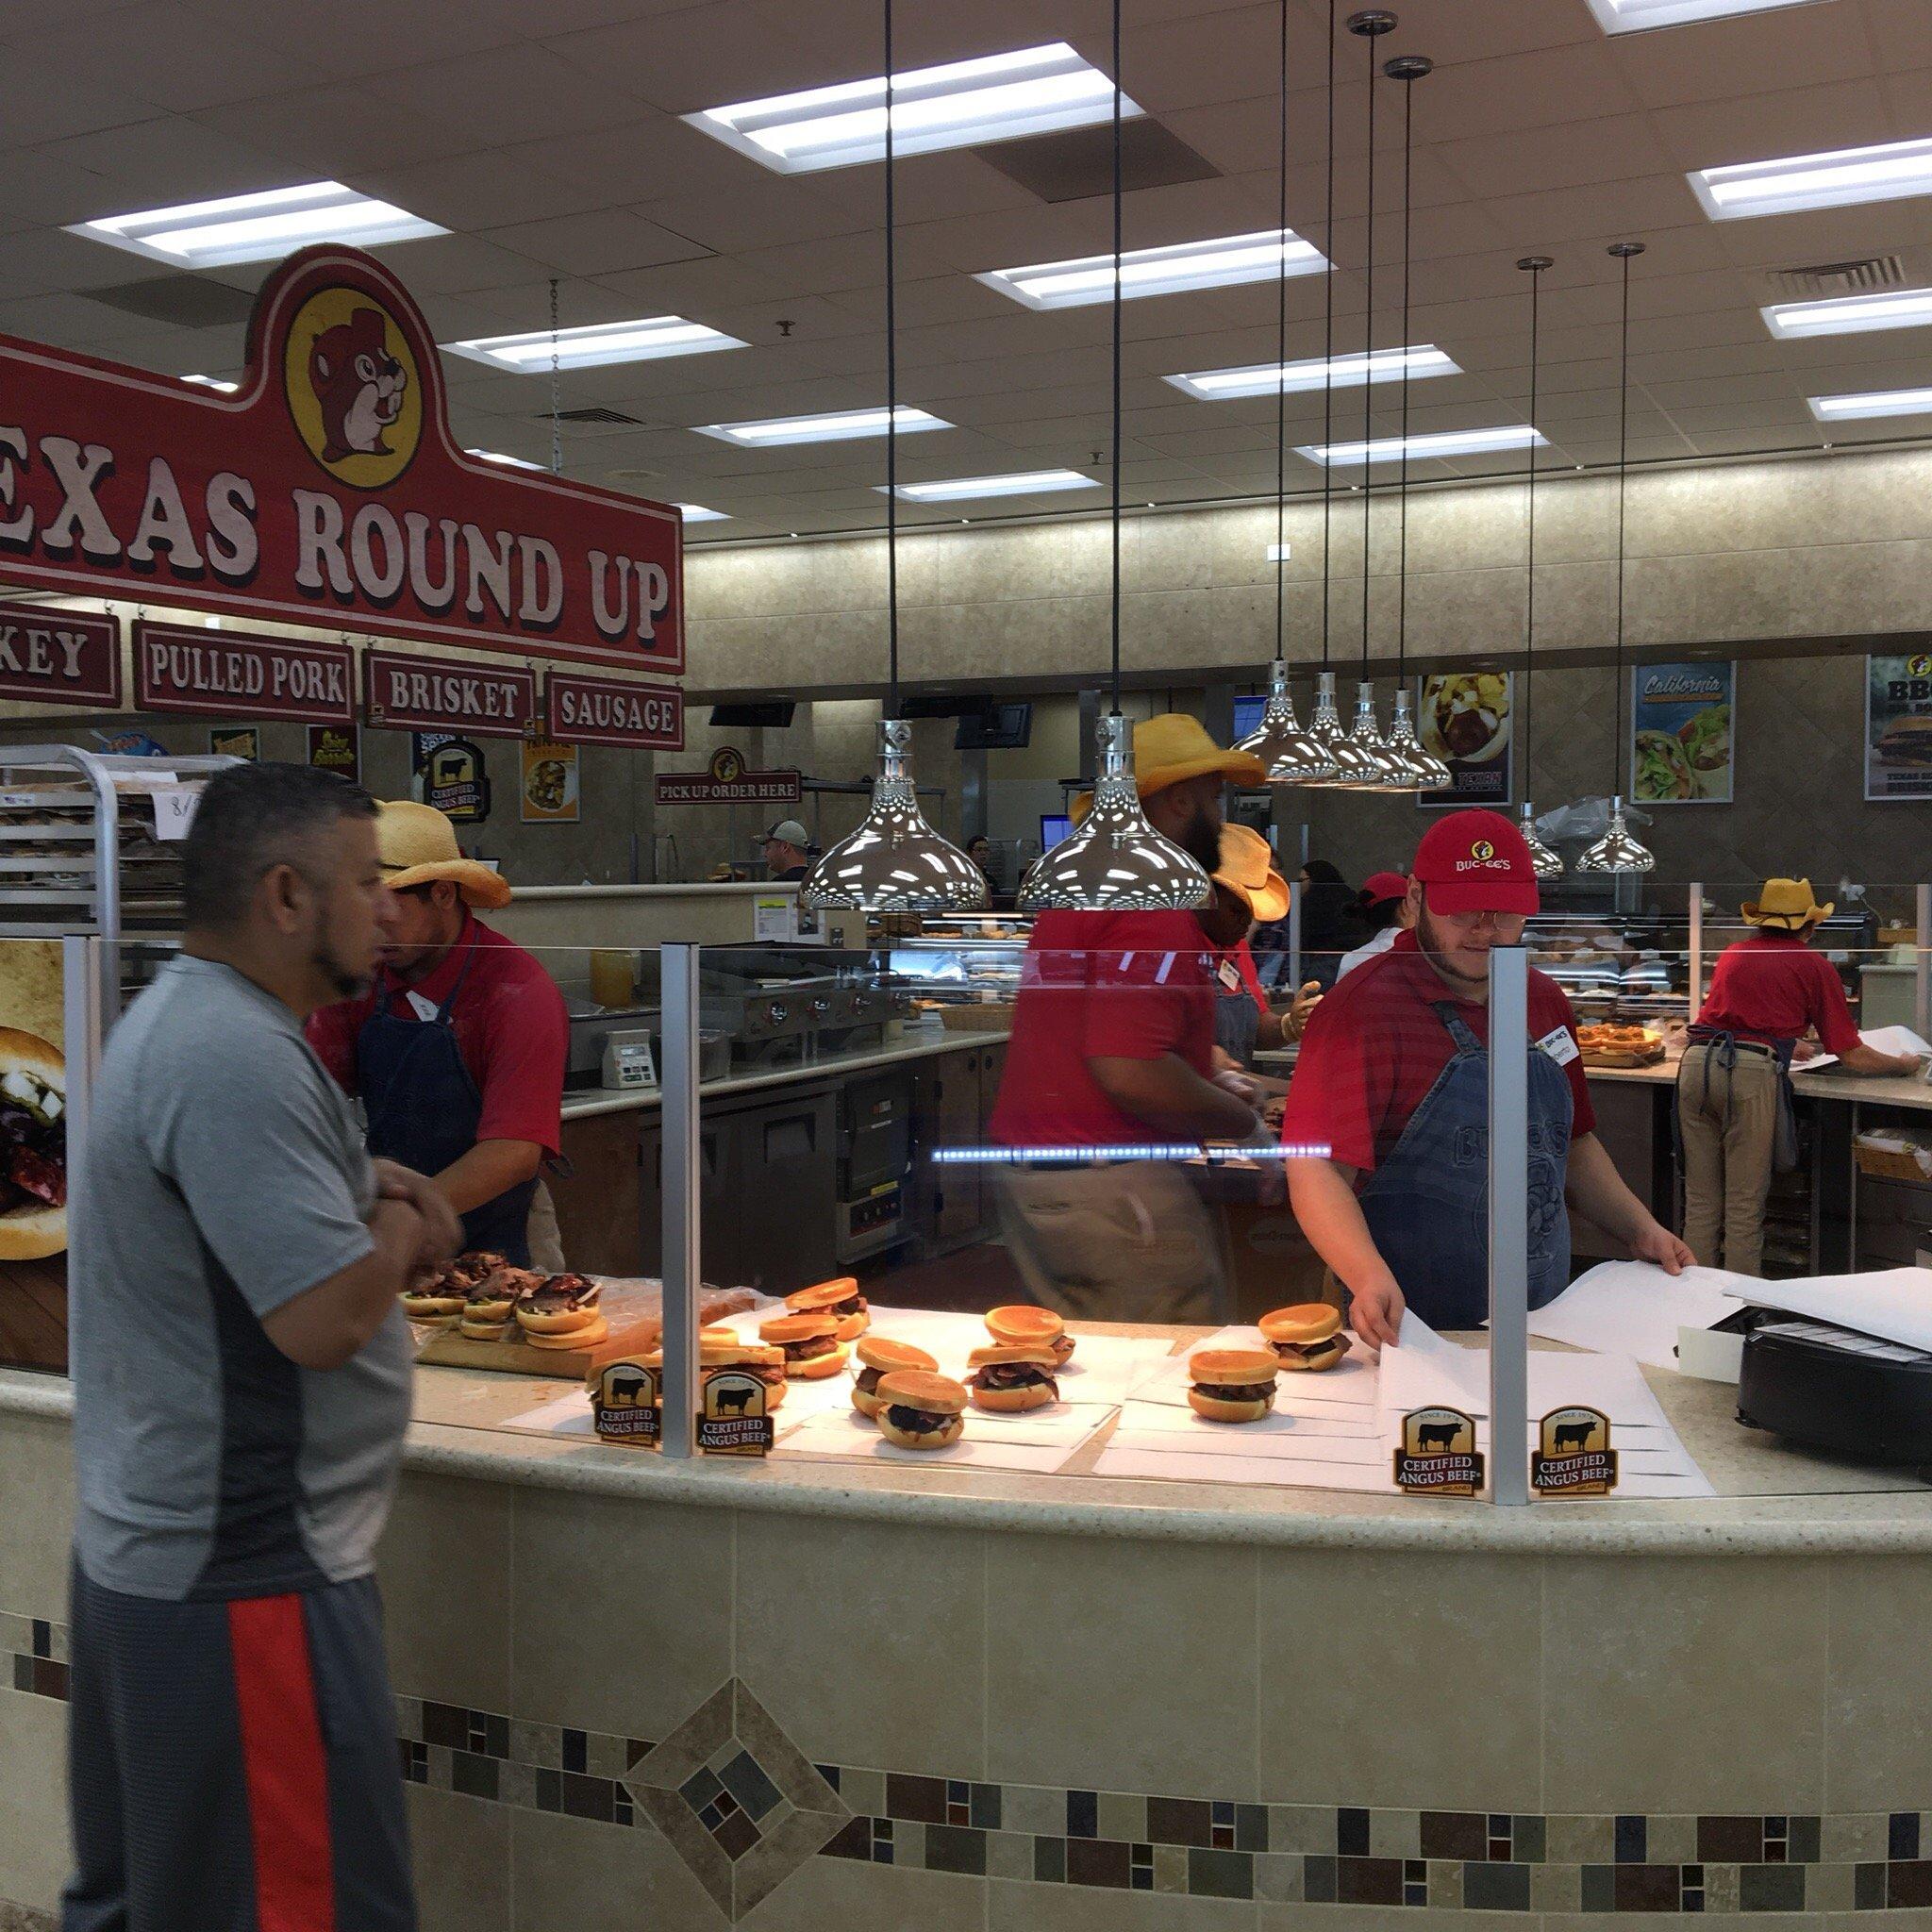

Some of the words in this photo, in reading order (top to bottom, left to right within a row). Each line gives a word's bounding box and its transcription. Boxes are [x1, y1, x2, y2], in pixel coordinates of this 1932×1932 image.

[292, 489, 563, 626] ROUND
[588, 550, 669, 642] UP
[150, 643, 264, 696] PULLED
[272, 657, 346, 703] PORK
[1644, 675, 1722, 695] California
[390, 671, 517, 719] BRISKET
[561, 691, 674, 732] SAUSAGE
[659, 786, 691, 798] PICK
[691, 786, 709, 797] UP
[711, 785, 757, 797] ORDER
[758, 784, 795, 796] HERE
[600, 1409, 653, 1422] CERTIFIED
[596, 1422, 631, 1434] ANGUS
[703, 1419, 764, 1434] CERTIFIED
[699, 1434, 740, 1446] ANGUS
[1403, 1457, 1473, 1472] CERTIFIED
[1540, 1454, 1606, 1474] CERTIFIED
[1398, 1472, 1444, 1484] ANGUS
[1535, 1472, 1579, 1487] ANGUS
